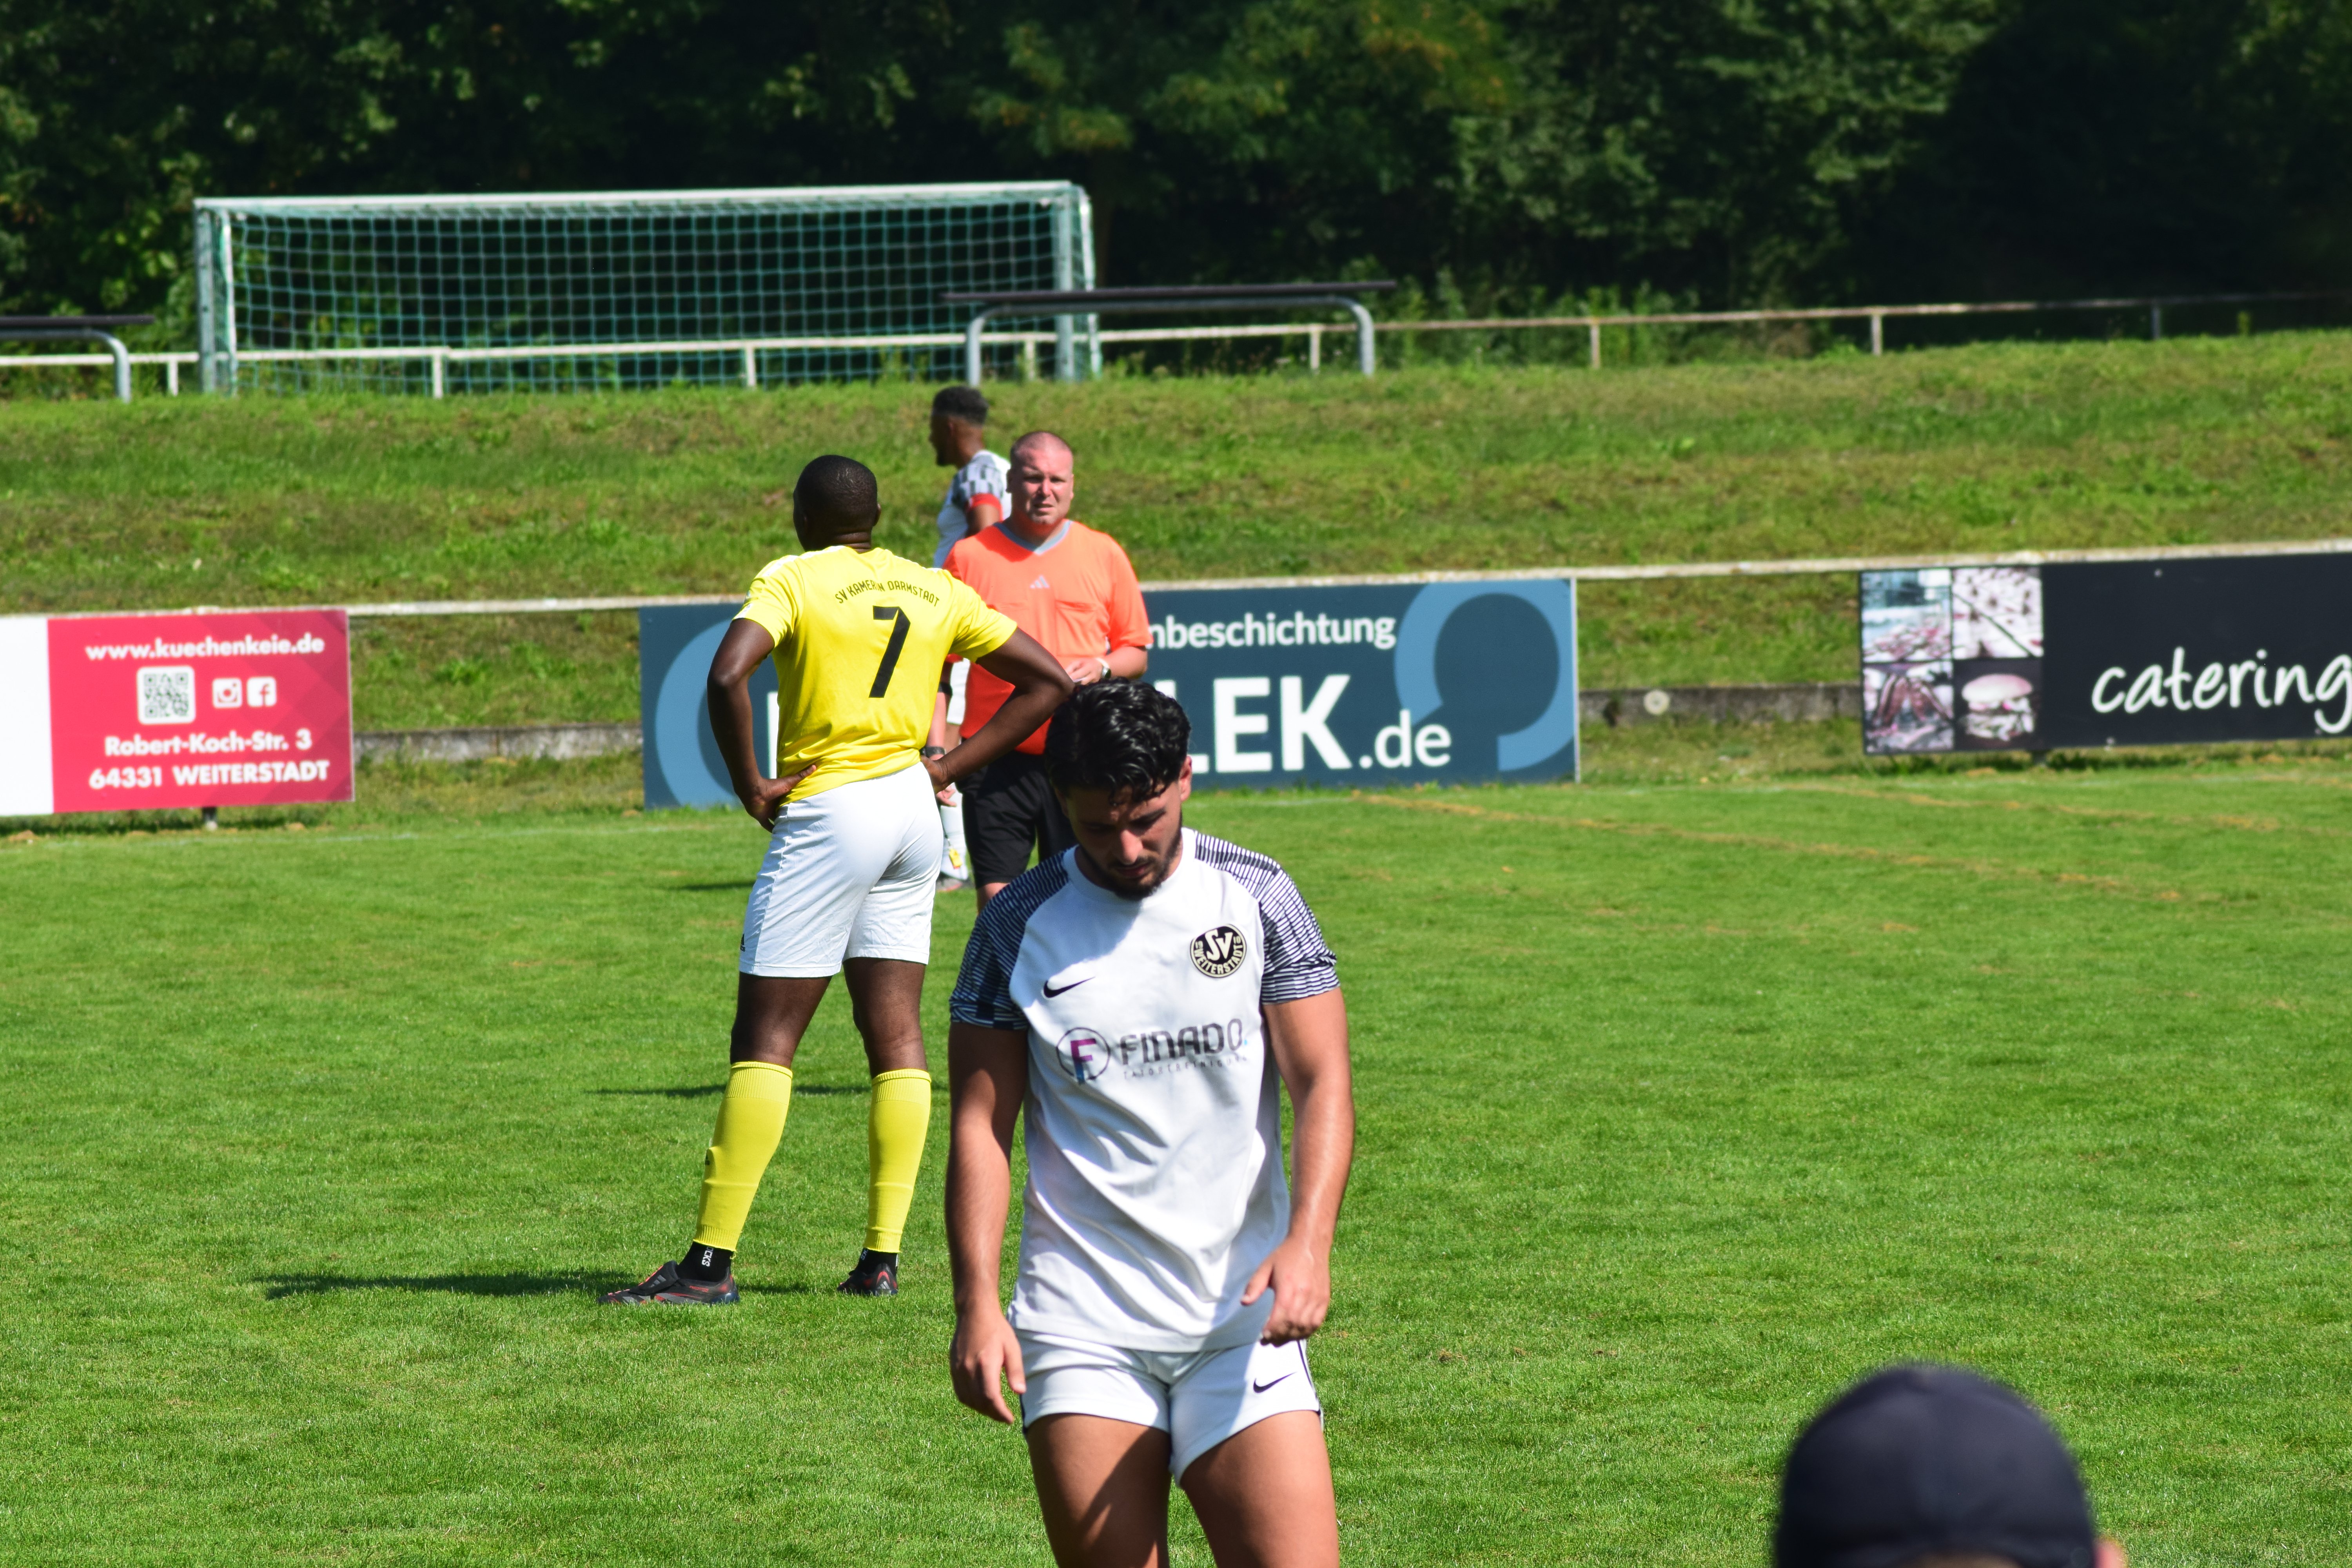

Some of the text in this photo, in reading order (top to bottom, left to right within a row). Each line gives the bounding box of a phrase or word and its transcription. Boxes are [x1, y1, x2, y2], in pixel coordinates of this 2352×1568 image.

[835, 580, 940, 607] SV KAMERN DARMSTADT
[85, 632, 325, 660] www.kuechenkeie.de
[869, 605, 911, 698] 7
[2091, 647, 2352, 734] catering
[1154, 674, 1452, 775] EK.de
[105, 728, 312, 757] Robert-Koch-Str. 3
[89, 760, 330, 789] 64331 WEITERSTADT
[1194, 944, 1243, 975] WEITERSTADT
[1205, 928, 1233, 961] SV
